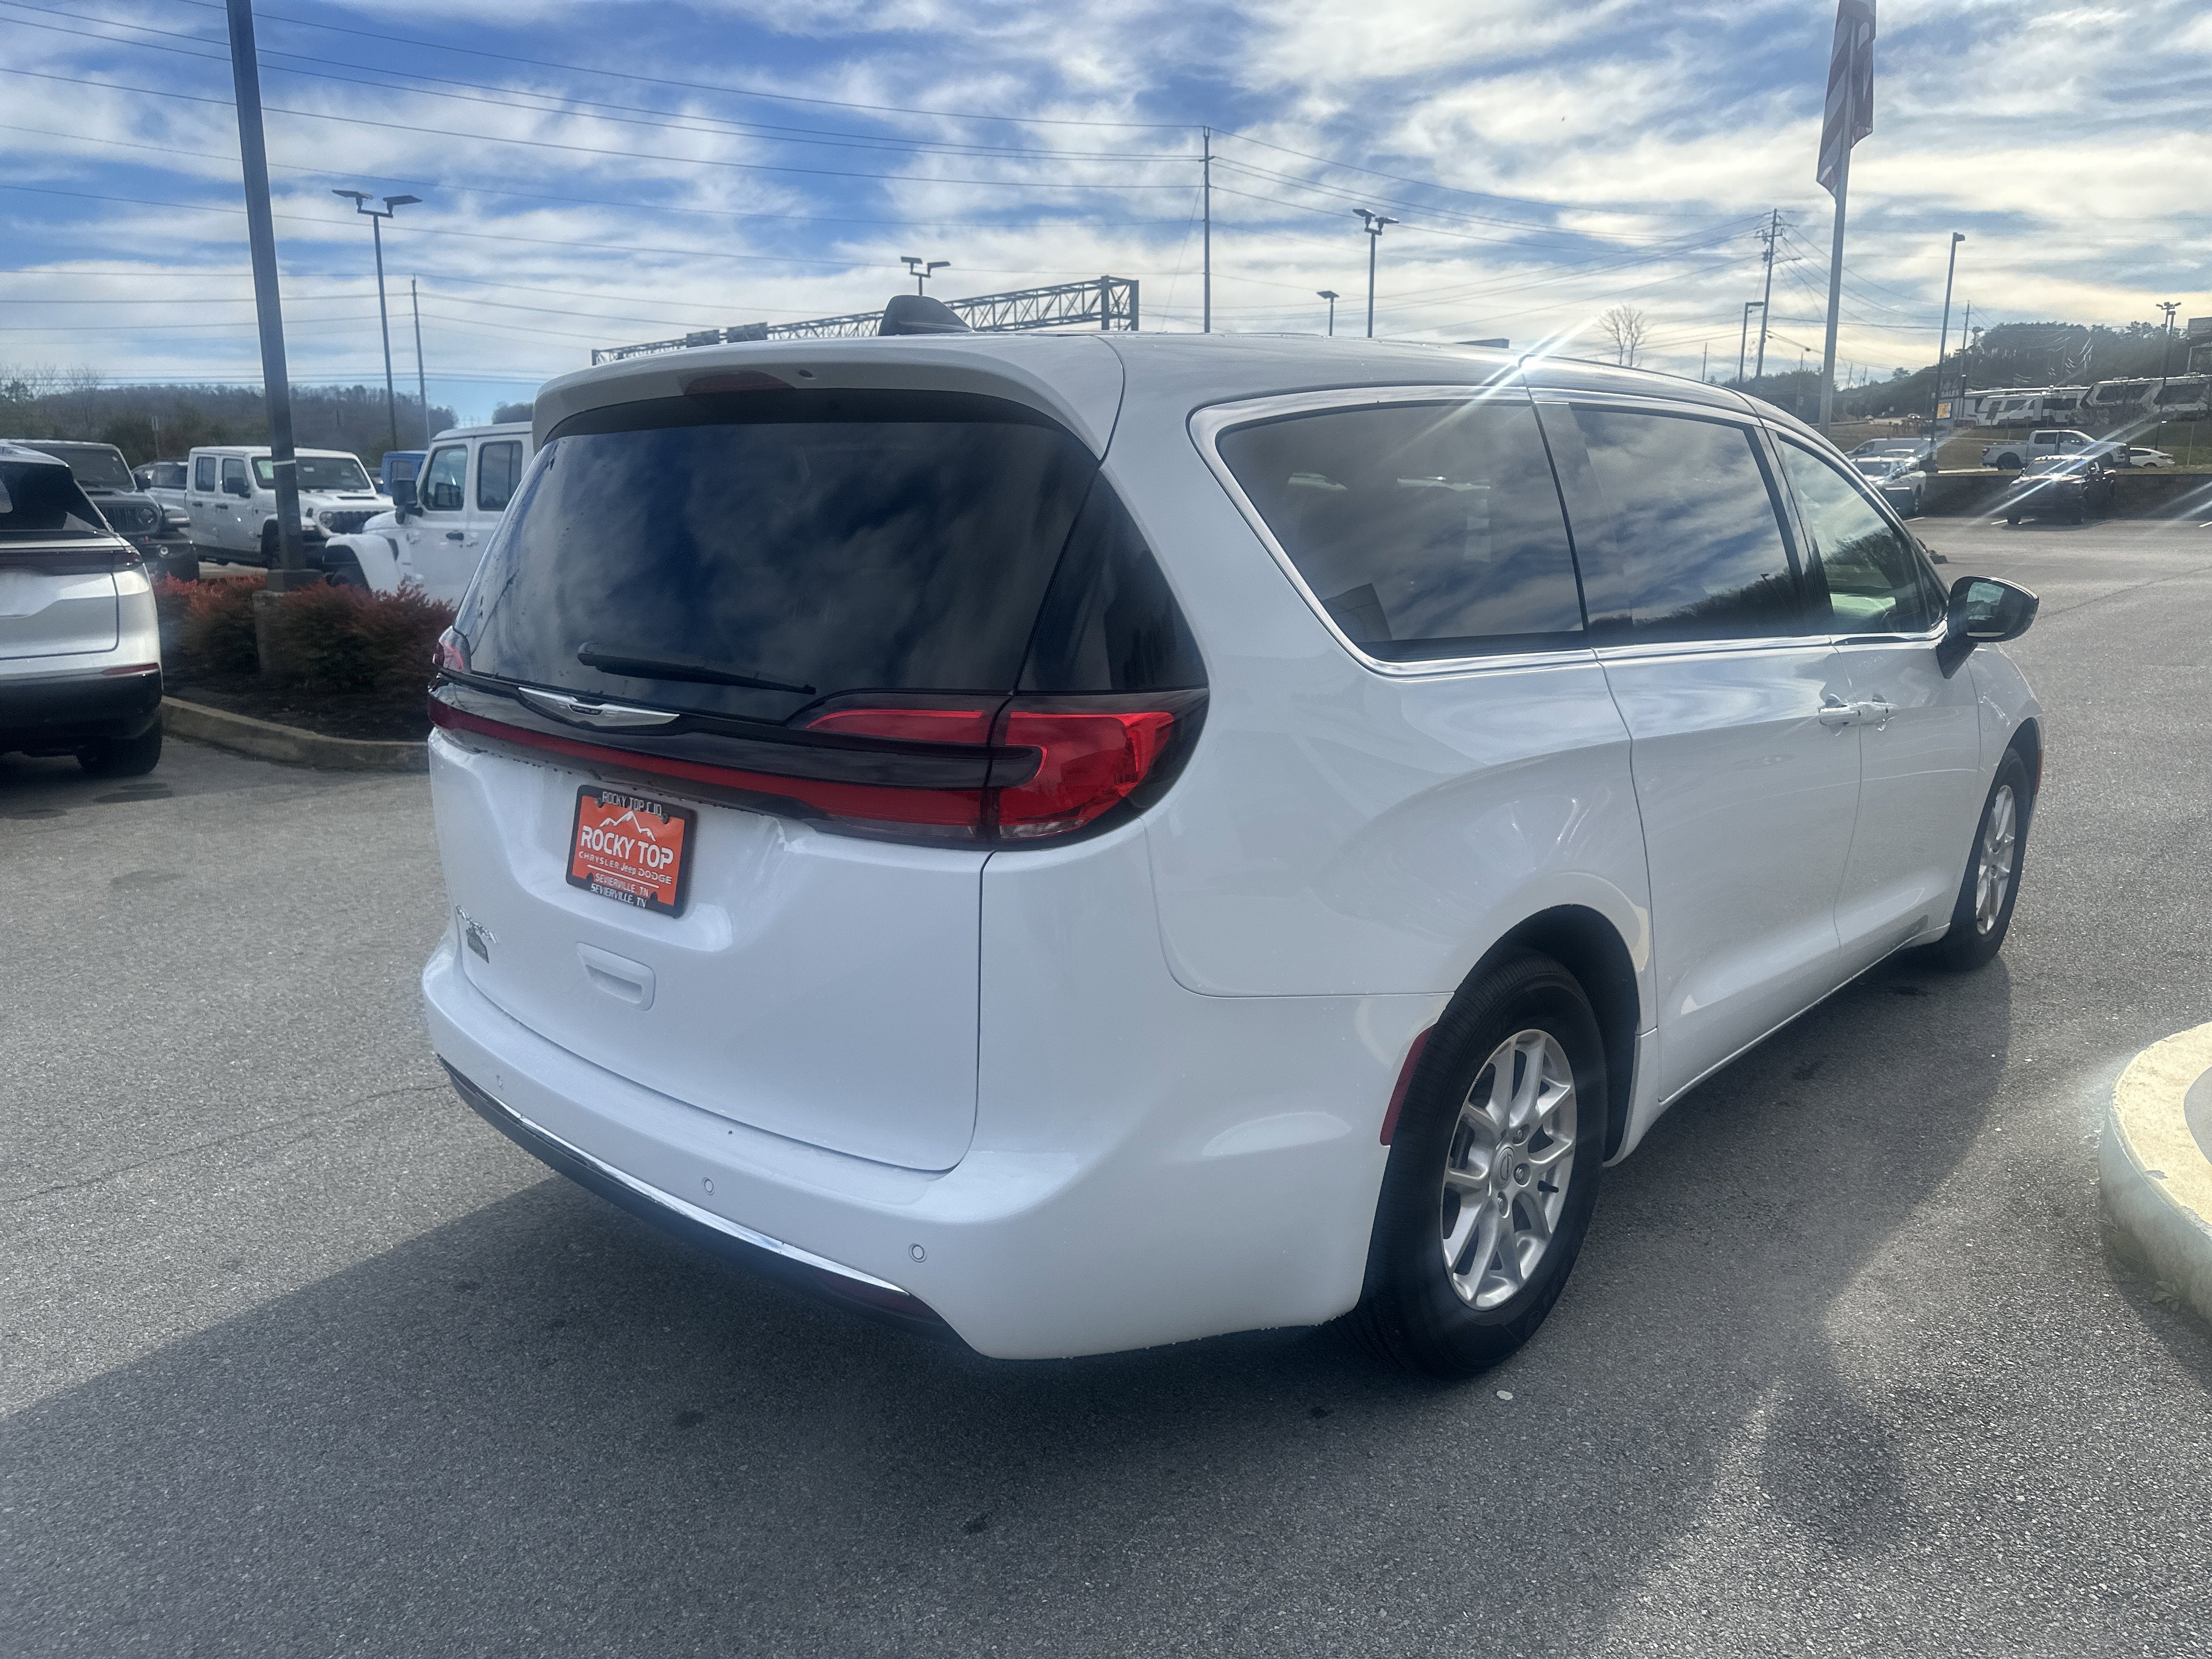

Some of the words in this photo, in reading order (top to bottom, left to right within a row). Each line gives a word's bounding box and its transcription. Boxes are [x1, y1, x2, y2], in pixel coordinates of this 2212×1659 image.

[602, 791, 627, 808] ROCKY
[629, 797, 645, 811] TOP
[580, 825, 635, 860] ROCKY
[637, 840, 674, 870] TOP
[578, 851, 619, 869] CHRYSLER
[620, 862, 636, 876] Jeep
[638, 868, 672, 885] DODGE
[636, 896, 647, 908] TN
[639, 886, 650, 898] TN
